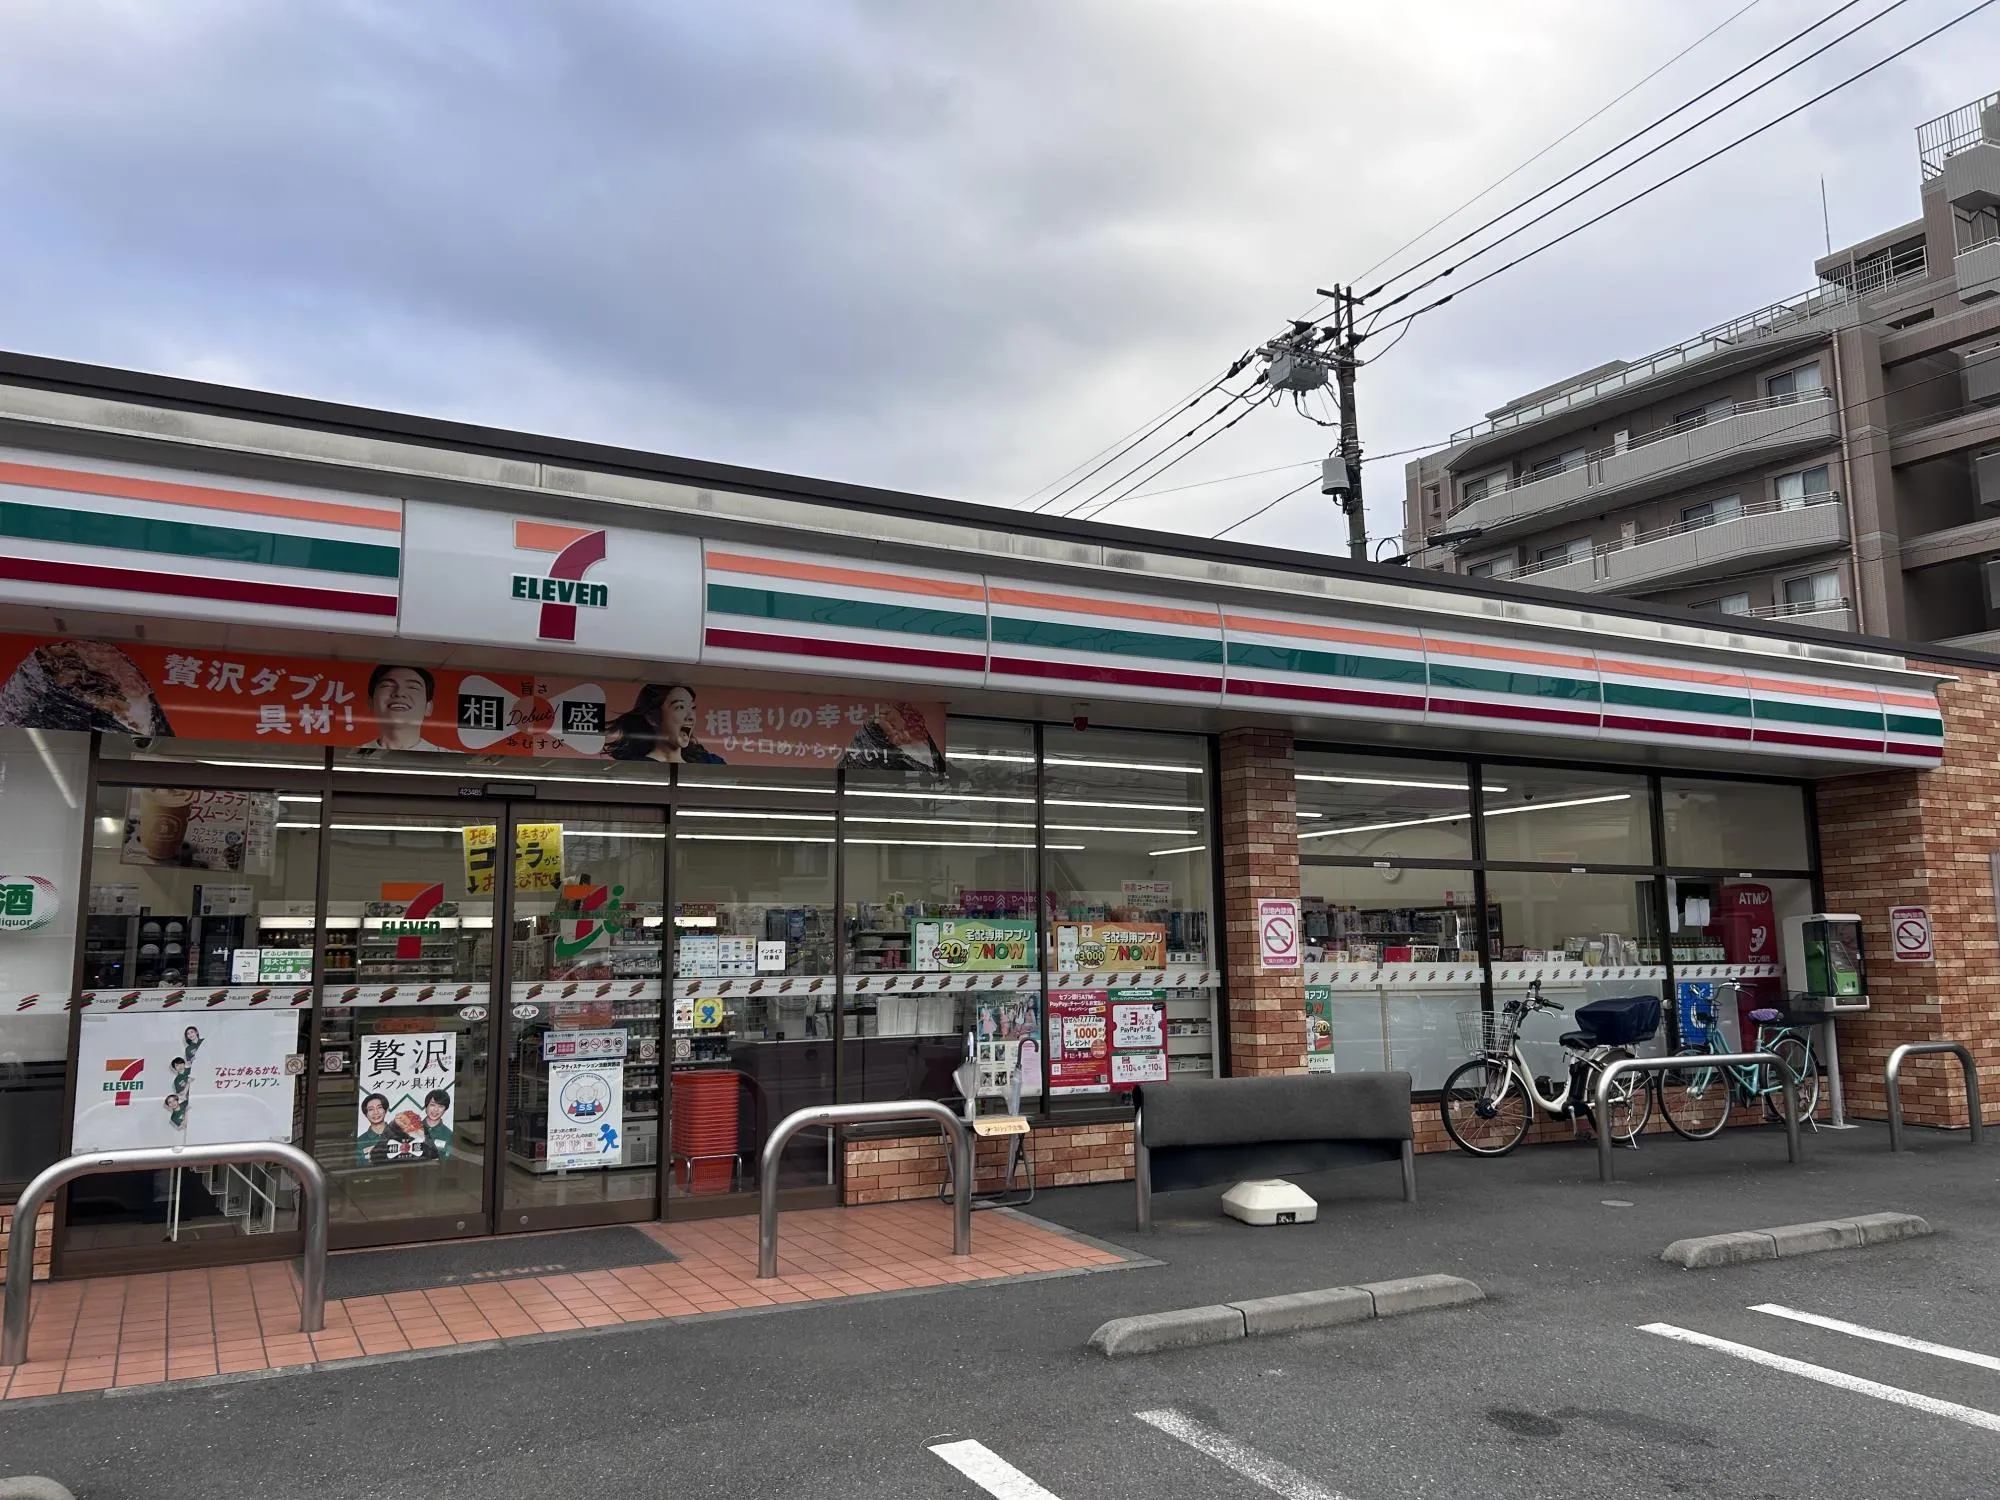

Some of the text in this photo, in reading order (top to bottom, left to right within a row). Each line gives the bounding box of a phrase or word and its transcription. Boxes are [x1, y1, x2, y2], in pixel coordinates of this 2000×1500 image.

[512, 575, 608, 607] ELEVEN
[163, 653, 355, 704] 贅沢ダブル
[520, 680, 548, 697] 旨さ
[255, 703, 355, 734] 具材!
[463, 697, 498, 728] 相
[505, 704, 560, 727] Debut!
[567, 703, 599, 733] 盛
[505, 737, 565, 750] おむすび
[188, 805, 244, 823] スムージー
[965, 895, 995, 903] DAISO
[1739, 892, 1761, 905] ATM
[381, 920, 441, 936] ELEVEN
[965, 929, 1032, 942] 宅配専用アプリ
[1101, 931, 1163, 943] 宅配専用アプリ
[973, 943, 1025, 960] 7NOW
[1109, 945, 1157, 961] 7NOW
[367, 1039, 449, 1077] 贅沢
[103, 1080, 144, 1092] ELEVEN
[371, 1077, 444, 1090] ダブル具材!
[578, 1103, 593, 1111] SS
